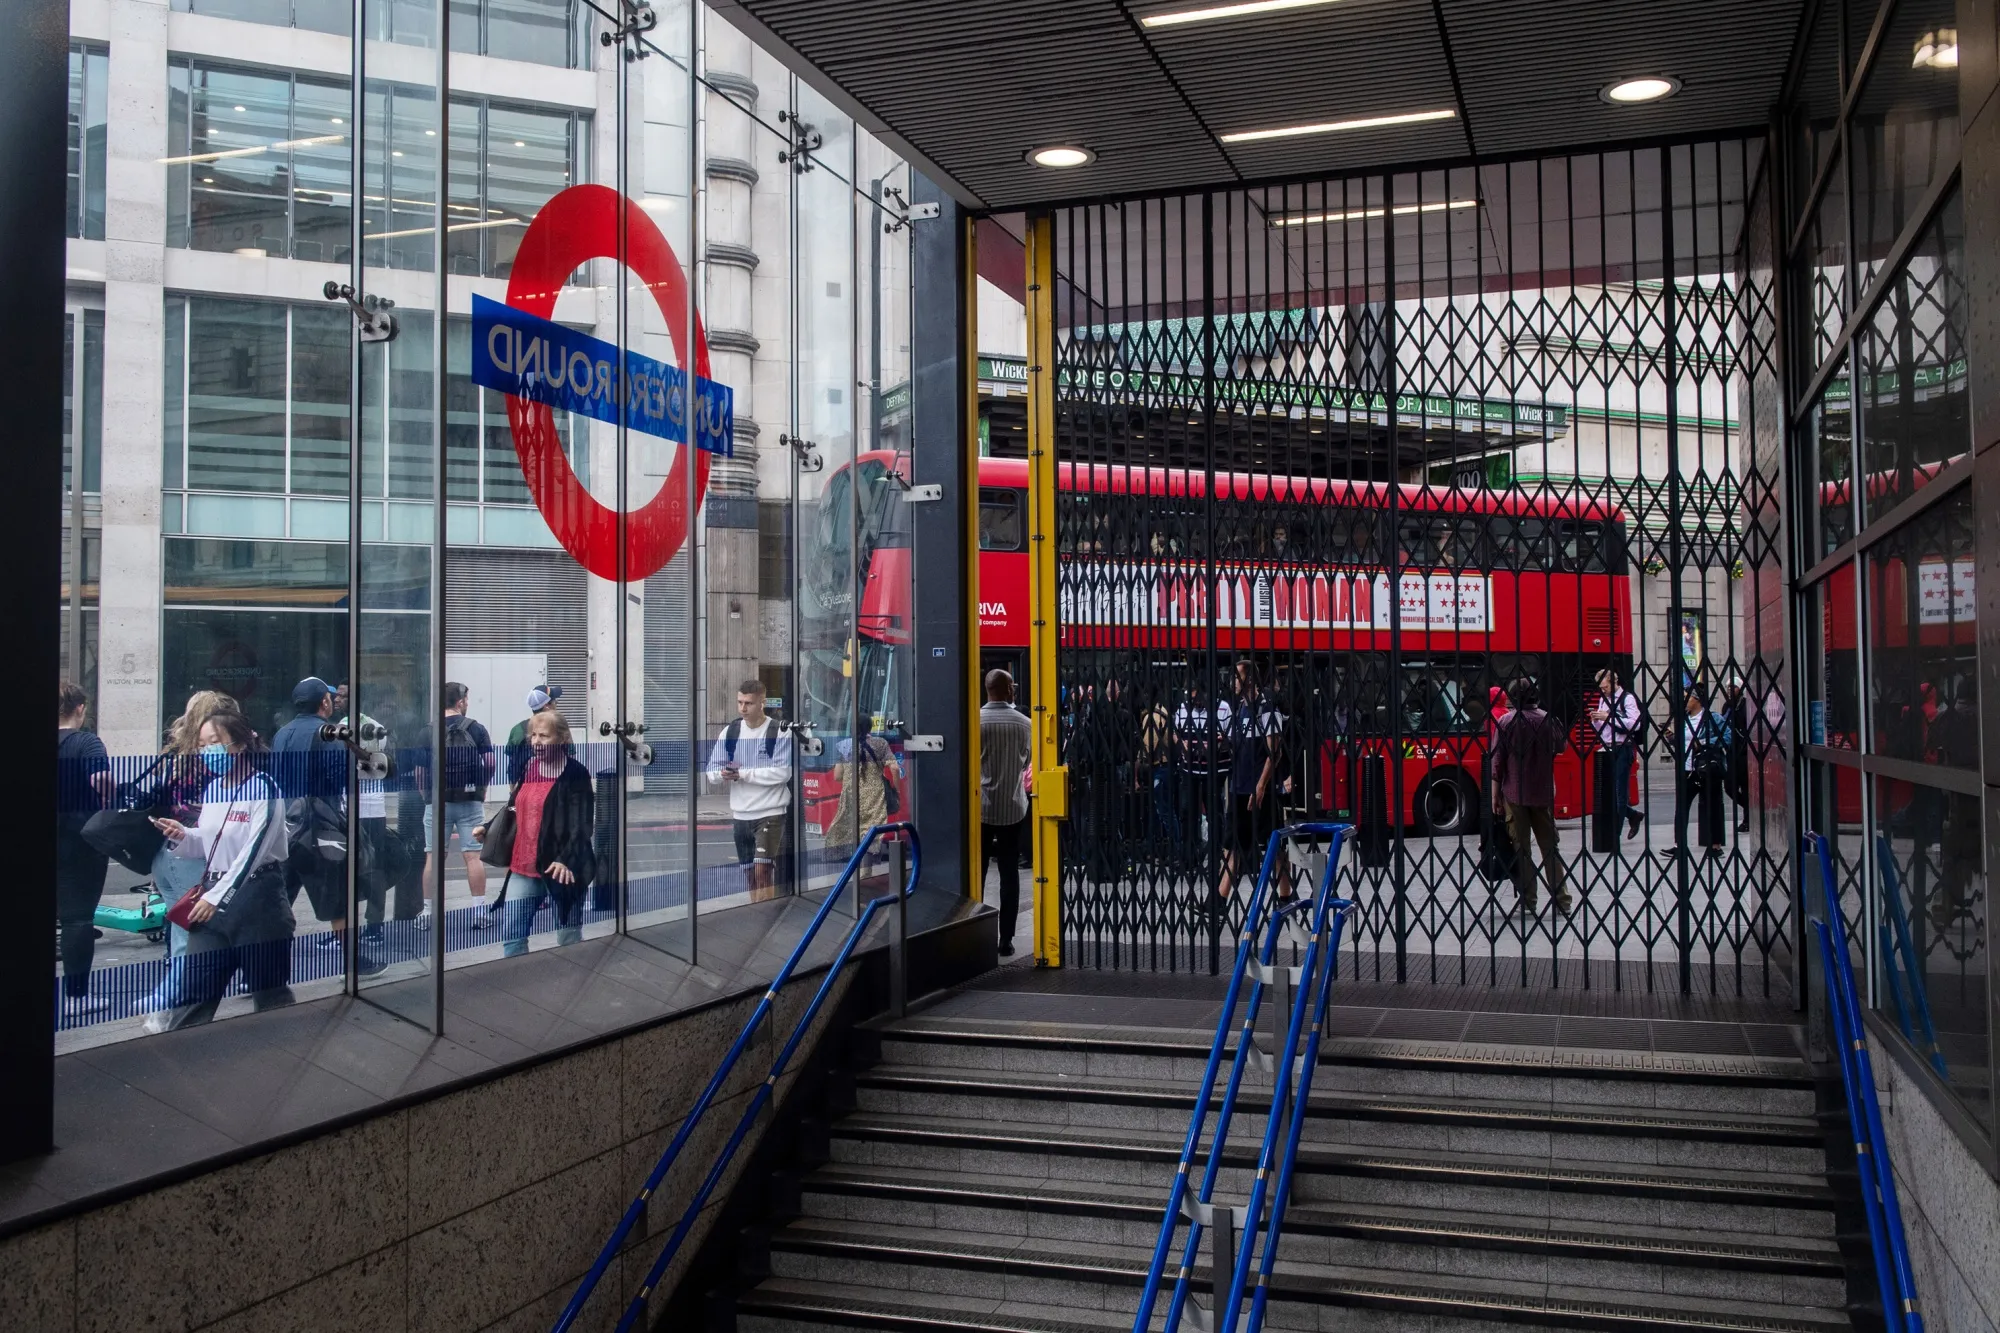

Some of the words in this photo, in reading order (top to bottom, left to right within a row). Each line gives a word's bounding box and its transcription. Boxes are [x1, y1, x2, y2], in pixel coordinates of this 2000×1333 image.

[990, 360, 1028, 380] WICKE
[886, 390, 906, 409] DEFYING
[1396, 396, 1414, 411] OF
[1417, 398, 1444, 414] ALL
[819, 592, 852, 609] Marylebone
[1273, 575, 1371, 622] WOMAN
[978, 602, 1007, 616] RIVA
[982, 619, 1008, 627] company
[121, 652, 136, 675] 5
[106, 678, 131, 686] WILTON
[134, 678, 153, 686] ROAD
